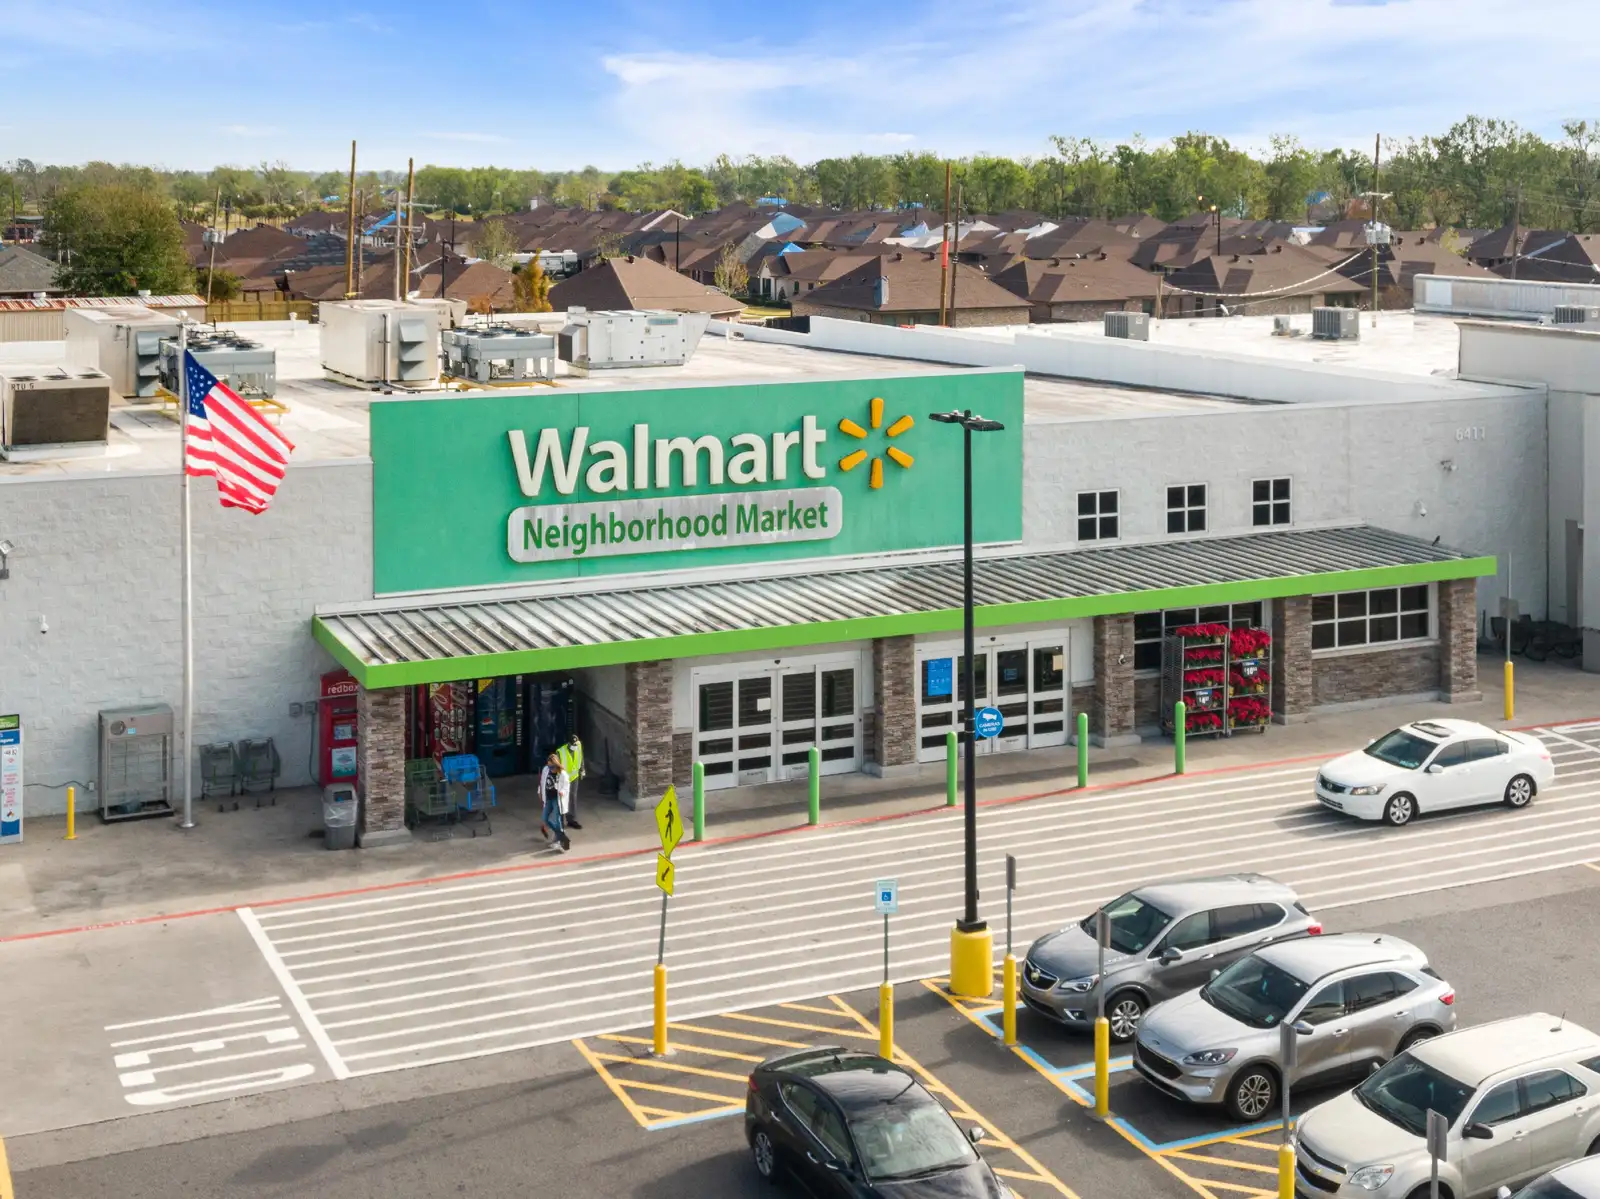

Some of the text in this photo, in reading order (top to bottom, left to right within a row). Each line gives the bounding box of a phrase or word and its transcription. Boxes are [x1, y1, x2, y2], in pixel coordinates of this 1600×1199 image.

[11, 383, 26, 391] RTU
[1456, 426, 1485, 441] 6411
[508, 415, 826, 497] Walmart
[523, 500, 829, 555] Neighborhood Market
[327, 684, 358, 694] redbox
[104, 996, 315, 1105] YIELD
